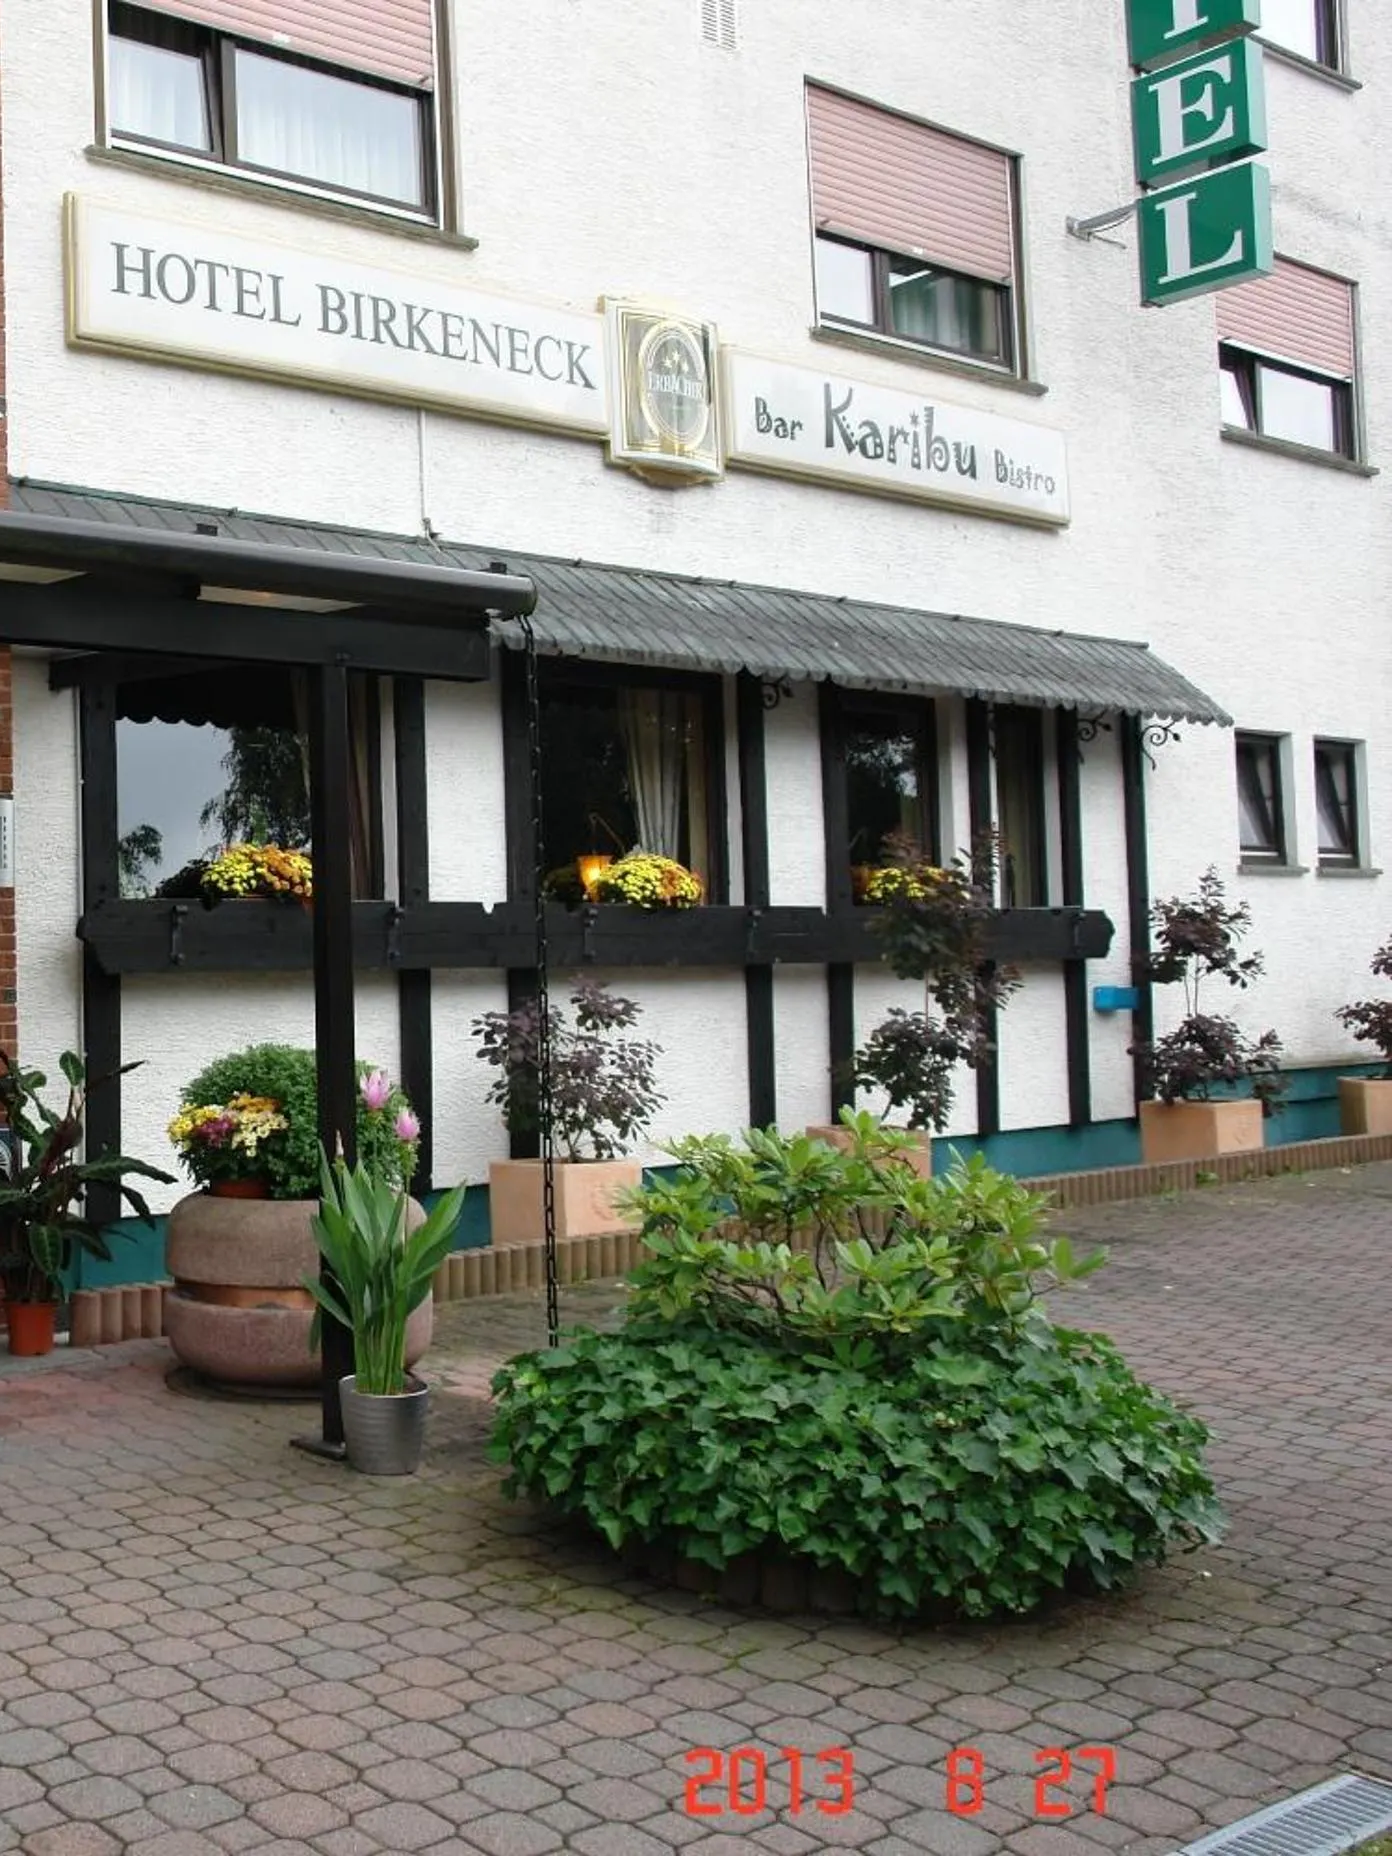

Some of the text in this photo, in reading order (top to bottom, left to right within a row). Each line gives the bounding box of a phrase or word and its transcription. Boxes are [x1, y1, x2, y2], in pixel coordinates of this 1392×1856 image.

[109, 241, 598, 391] HOTEL BIRKENECK
[754, 381, 1056, 496] Bar Karibu Bistro
